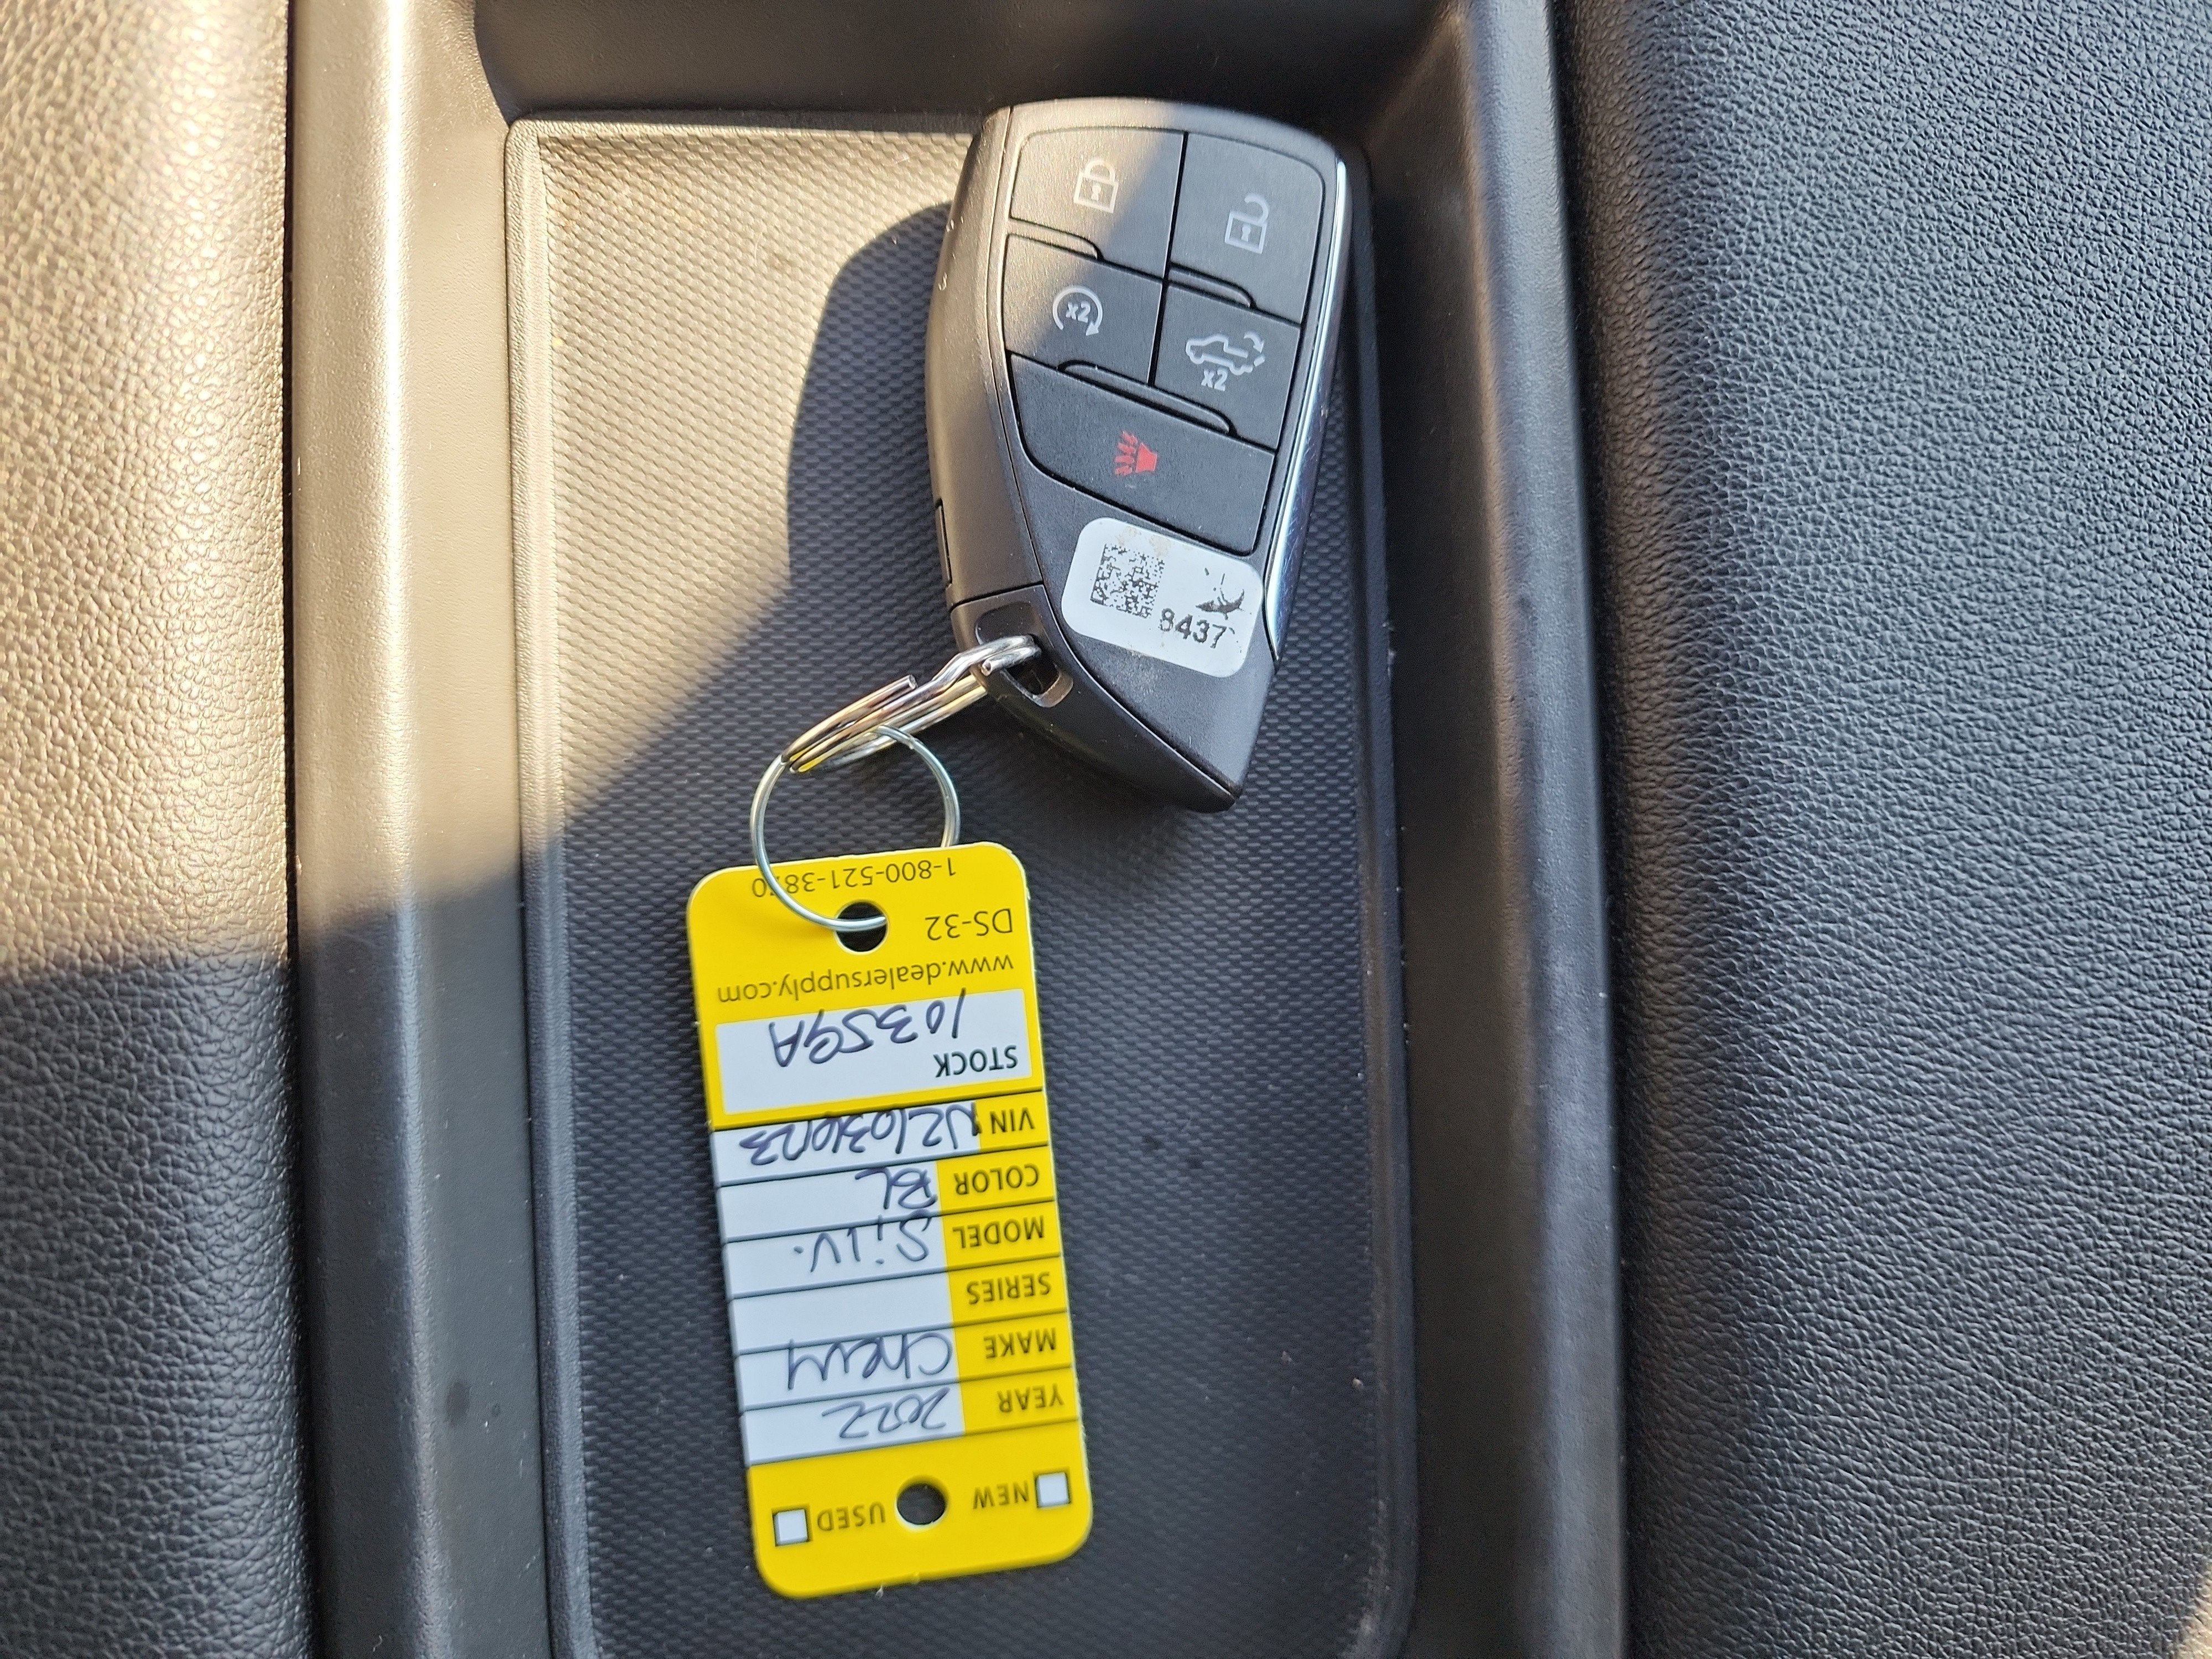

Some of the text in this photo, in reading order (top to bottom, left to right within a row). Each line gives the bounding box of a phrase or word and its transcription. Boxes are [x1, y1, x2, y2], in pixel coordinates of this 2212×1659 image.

[1066, 301, 1091, 324] x2
[1201, 368, 1228, 392] x2
[1159, 608, 1228, 649] 8437
[924, 907, 1013, 940] DS-32
[716, 954, 1013, 1005] www.dealersupply.com
[768, 988, 967, 1068] 10359A
[932, 1044, 1019, 1078] STOCK
[989, 1106, 1034, 1134] VIN
[853, 1165, 938, 1209] BL
[954, 1164, 1039, 1194] COLOR
[952, 1214, 1044, 1248] MODEL
[966, 1271, 1050, 1304] SERIES
[983, 1327, 1056, 1359] MAKE
[786, 1331, 952, 1390] Chevy
[821, 1386, 950, 1439] 2022
[996, 1383, 1063, 1413] YEAR
[971, 1481, 1029, 1509] NEW
[816, 1501, 886, 1531] USED
